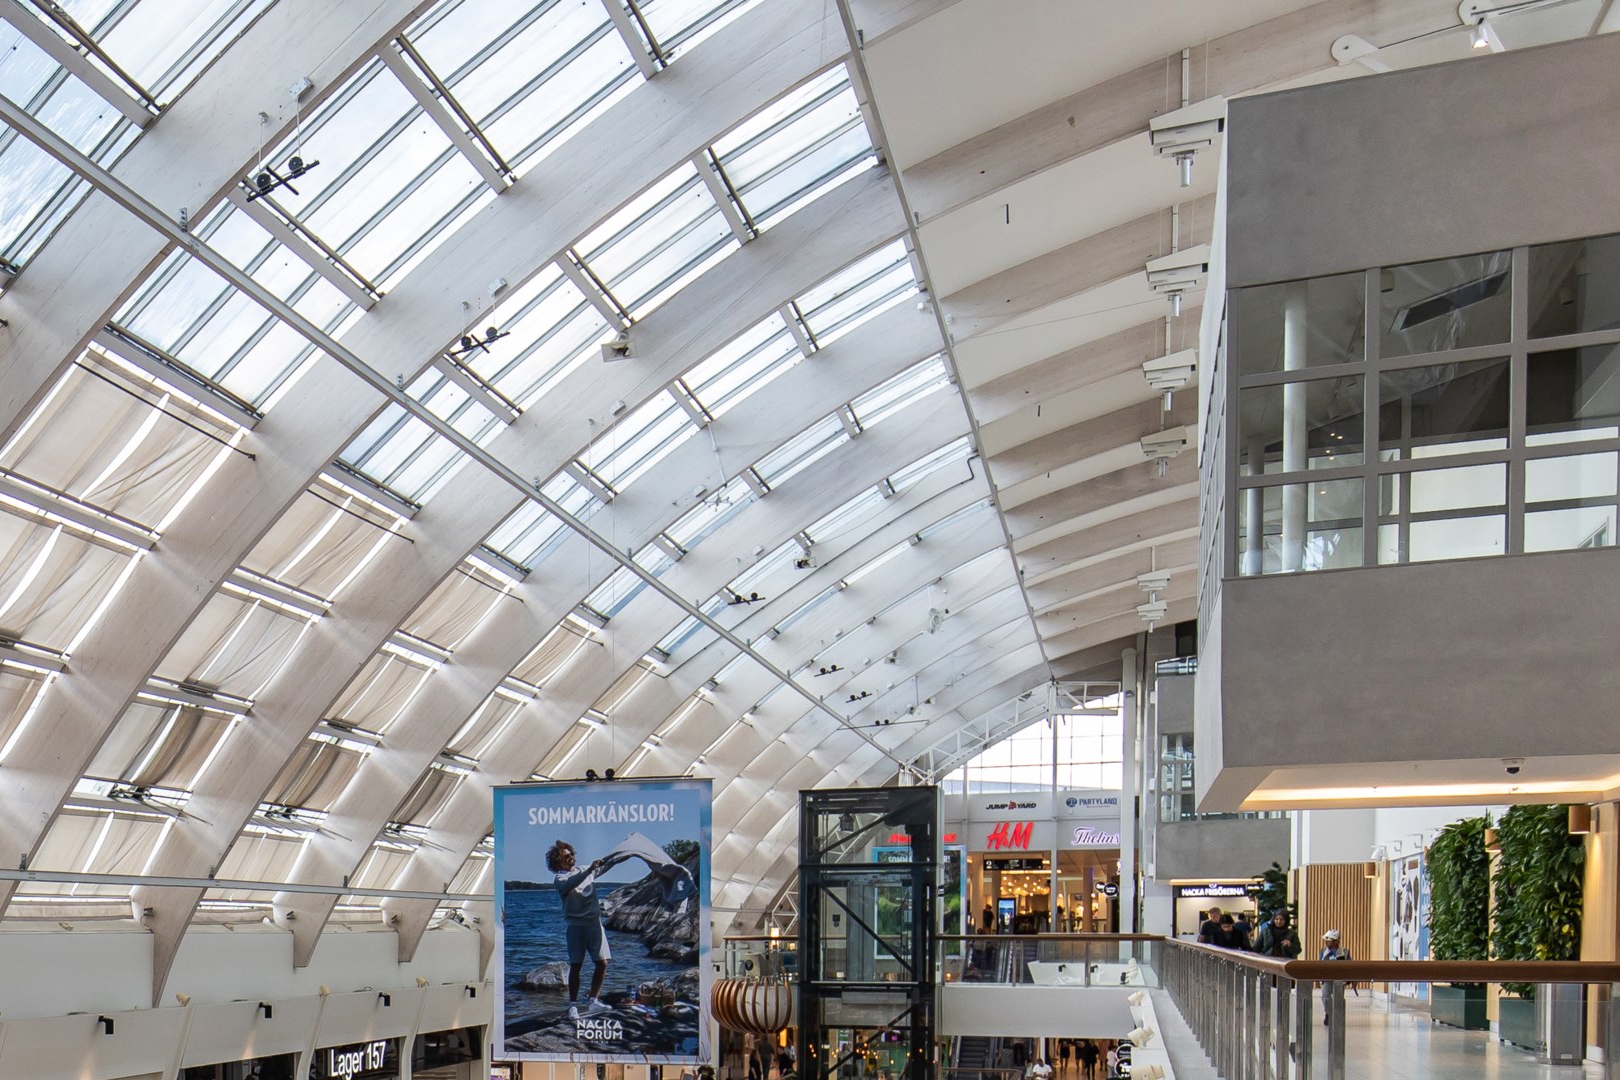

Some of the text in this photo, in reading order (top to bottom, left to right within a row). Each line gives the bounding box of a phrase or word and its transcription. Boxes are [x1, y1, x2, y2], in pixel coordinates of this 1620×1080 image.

[1017, 802, 1036, 810] YARD
[1079, 798, 1117, 806] PARTYLAND
[529, 801, 674, 825] SOMMARKÄNSLOR!
[987, 821, 1034, 850] H&M
[986, 860, 992, 869] 2
[1182, 888, 1204, 896] NACKA
[577, 1020, 622, 1029] NACKA
[577, 1030, 622, 1040] FORUM
[366, 1041, 386, 1070] 157
